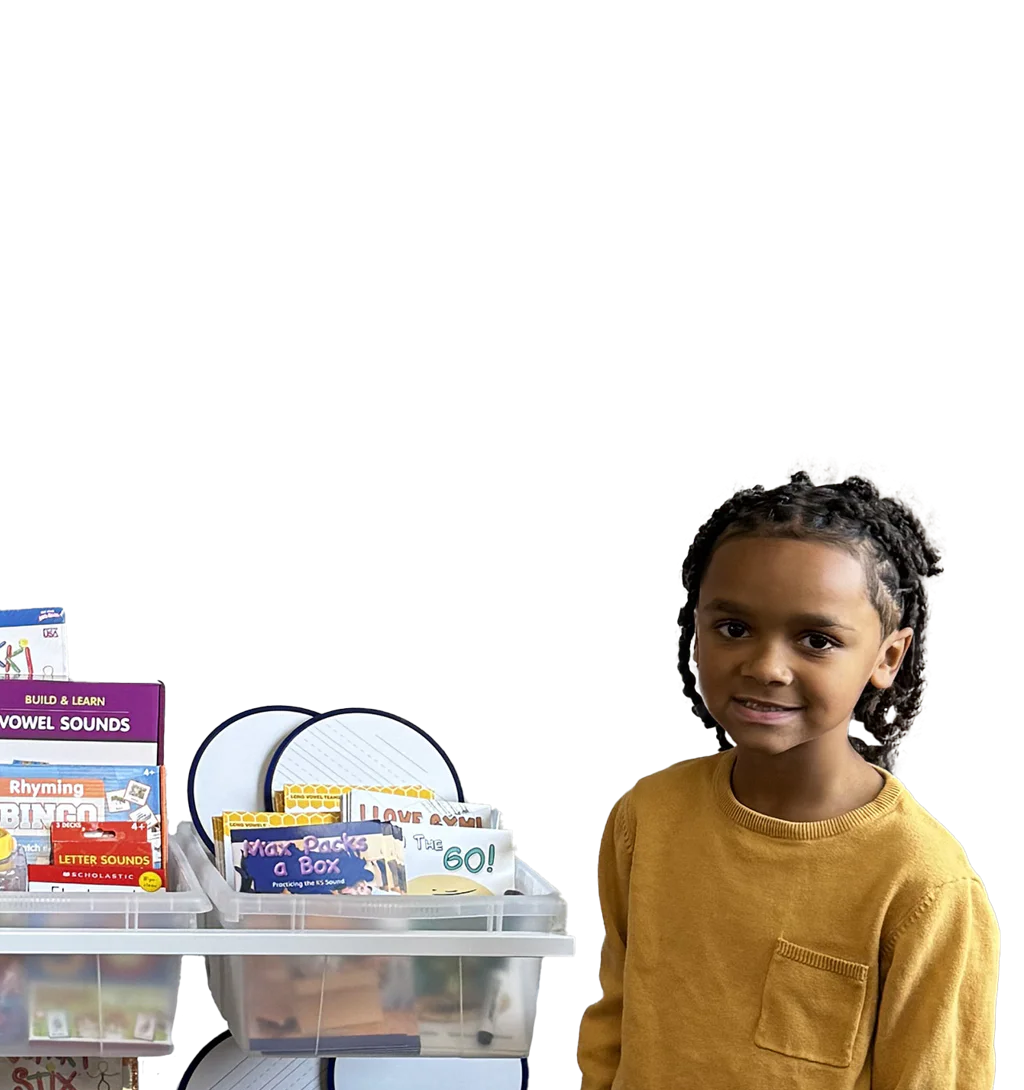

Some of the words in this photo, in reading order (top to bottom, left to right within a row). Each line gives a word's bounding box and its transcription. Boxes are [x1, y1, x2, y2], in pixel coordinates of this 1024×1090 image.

[25, 695, 57, 705] BUILD
[60, 696, 69, 705] &
[72, 696, 106, 706] LEARN
[60, 716, 130, 732] SOUNDS
[143, 768, 156, 777] 4+
[9, 779, 84, 798] Rhyming
[131, 822, 145, 831] 4+
[242, 838, 297, 858] Max
[303, 832, 369, 856] Packs
[59, 855, 97, 865] LETTER
[101, 855, 150, 866] SOUNDS
[274, 861, 288, 877] a
[298, 855, 342, 876] Box
[72, 872, 134, 880] SCHOLASTIC
[273, 880, 303, 889] Practicing
[304, 880, 315, 888] the
[325, 878, 345, 887] Sound
